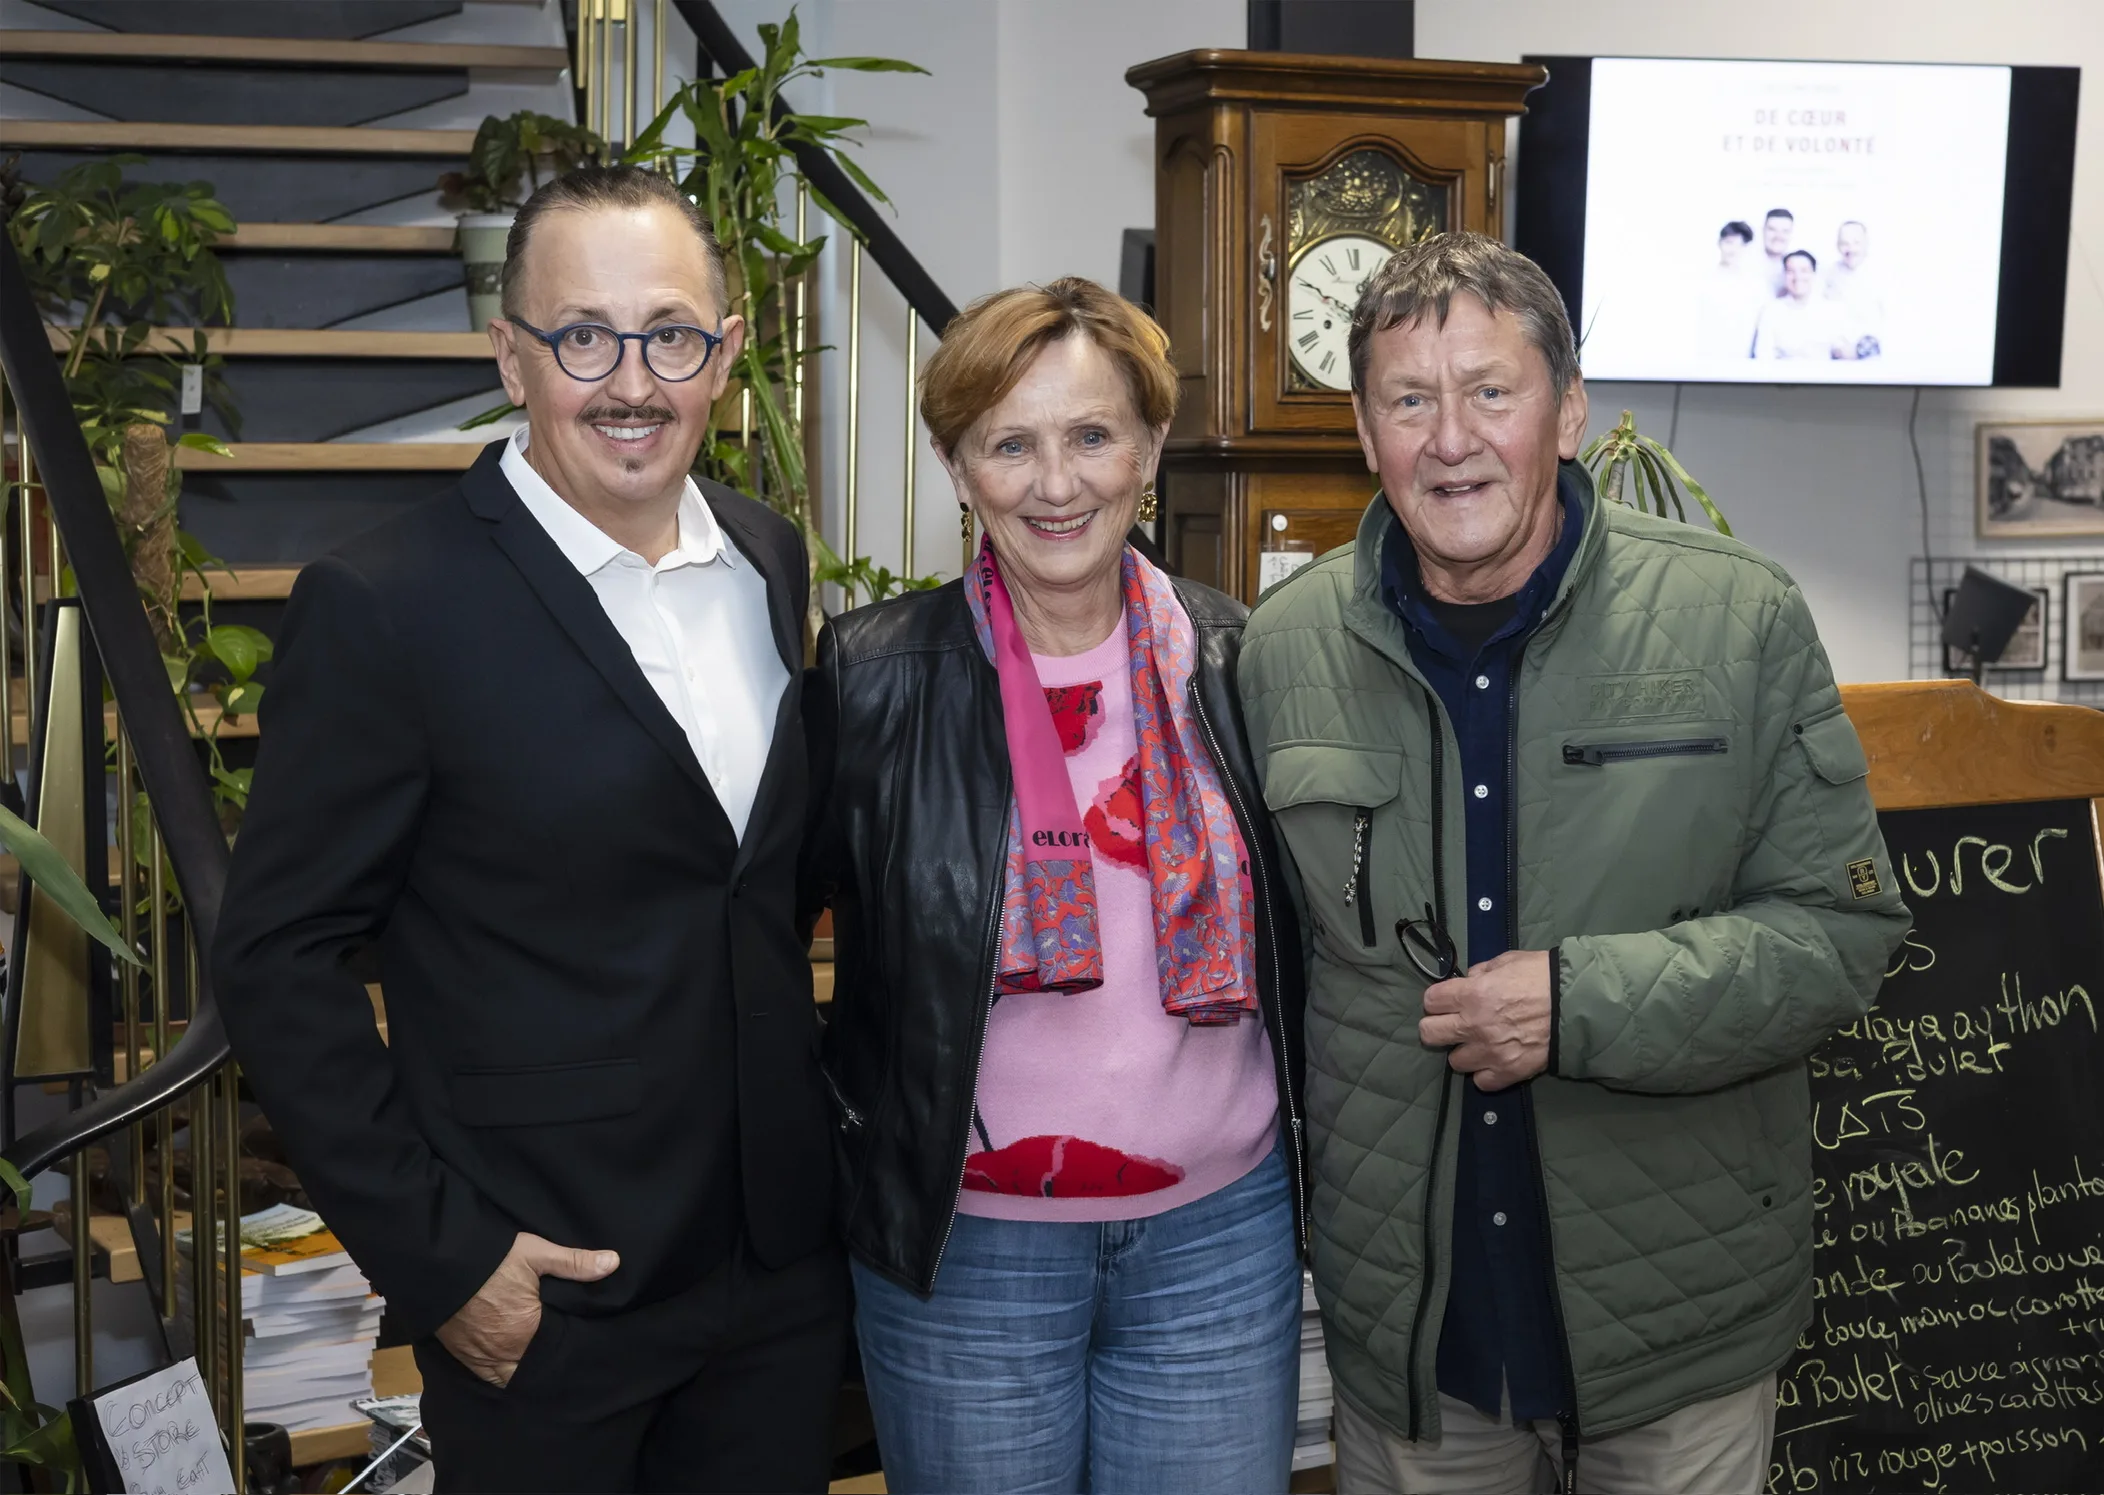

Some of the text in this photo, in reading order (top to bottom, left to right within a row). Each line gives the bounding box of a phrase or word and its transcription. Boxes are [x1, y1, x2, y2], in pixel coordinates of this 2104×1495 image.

[1754, 109, 1848, 127] DE CŒUR
[1722, 134, 1744, 152] ET
[1753, 136, 1776, 151] DE
[1903, 828, 2068, 897] urer
[1813, 1254, 1906, 1299] ande
[1912, 1262, 1942, 1284] ou
[1796, 1351, 1904, 1409] Poulet
[1922, 1360, 2006, 1390] sauce
